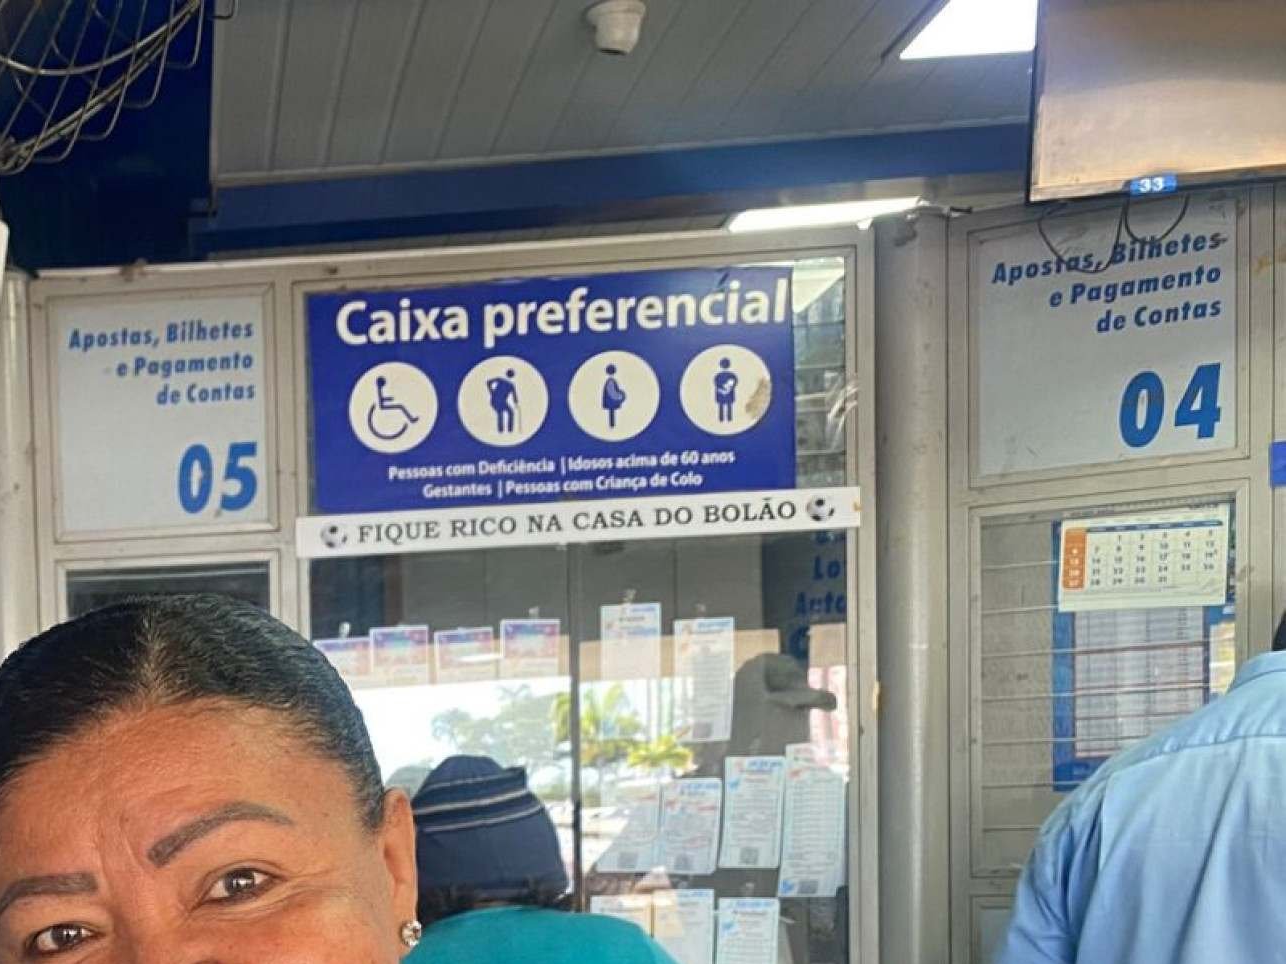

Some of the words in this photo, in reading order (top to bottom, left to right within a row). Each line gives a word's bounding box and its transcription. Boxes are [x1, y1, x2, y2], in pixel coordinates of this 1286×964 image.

[992, 253, 1103, 286] Apostas,
[1110, 231, 1222, 265] Bilhetes
[1050, 291, 1062, 307] e
[1070, 264, 1221, 305] Pagamento
[335, 298, 470, 347] Caixa
[483, 278, 788, 348] preferencial
[1096, 309, 1126, 333] de
[1134, 299, 1221, 328] Contas
[69, 327, 160, 352] Apostas,
[166, 319, 254, 344] Bilhetes
[116, 362, 128, 377] e
[134, 351, 254, 379] Pagamento
[156, 384, 181, 406] de
[186, 383, 256, 404] Contas
[1119, 362, 1221, 448] 04
[178, 441, 258, 514] 05
[388, 465, 443, 480] Pessoas
[446, 463, 475, 477] com
[478, 459, 556, 475] Deficiência
[616, 454, 657, 469] acima
[660, 452, 678, 466] de
[681, 450, 699, 465] 60
[701, 450, 736, 464] anos
[422, 483, 492, 498] Gestantes
[505, 480, 561, 495] Pessoas
[564, 478, 594, 492] com
[596, 475, 647, 492] Criança
[650, 472, 668, 487] de
[671, 470, 703, 487] Colo
[358, 520, 441, 546] FIQUE
[450, 515, 516, 538] RICO
[528, 513, 563, 533] NA
[573, 509, 644, 531] CASA
[654, 506, 693, 526] DO
[703, 497, 797, 525] BOLÃO
